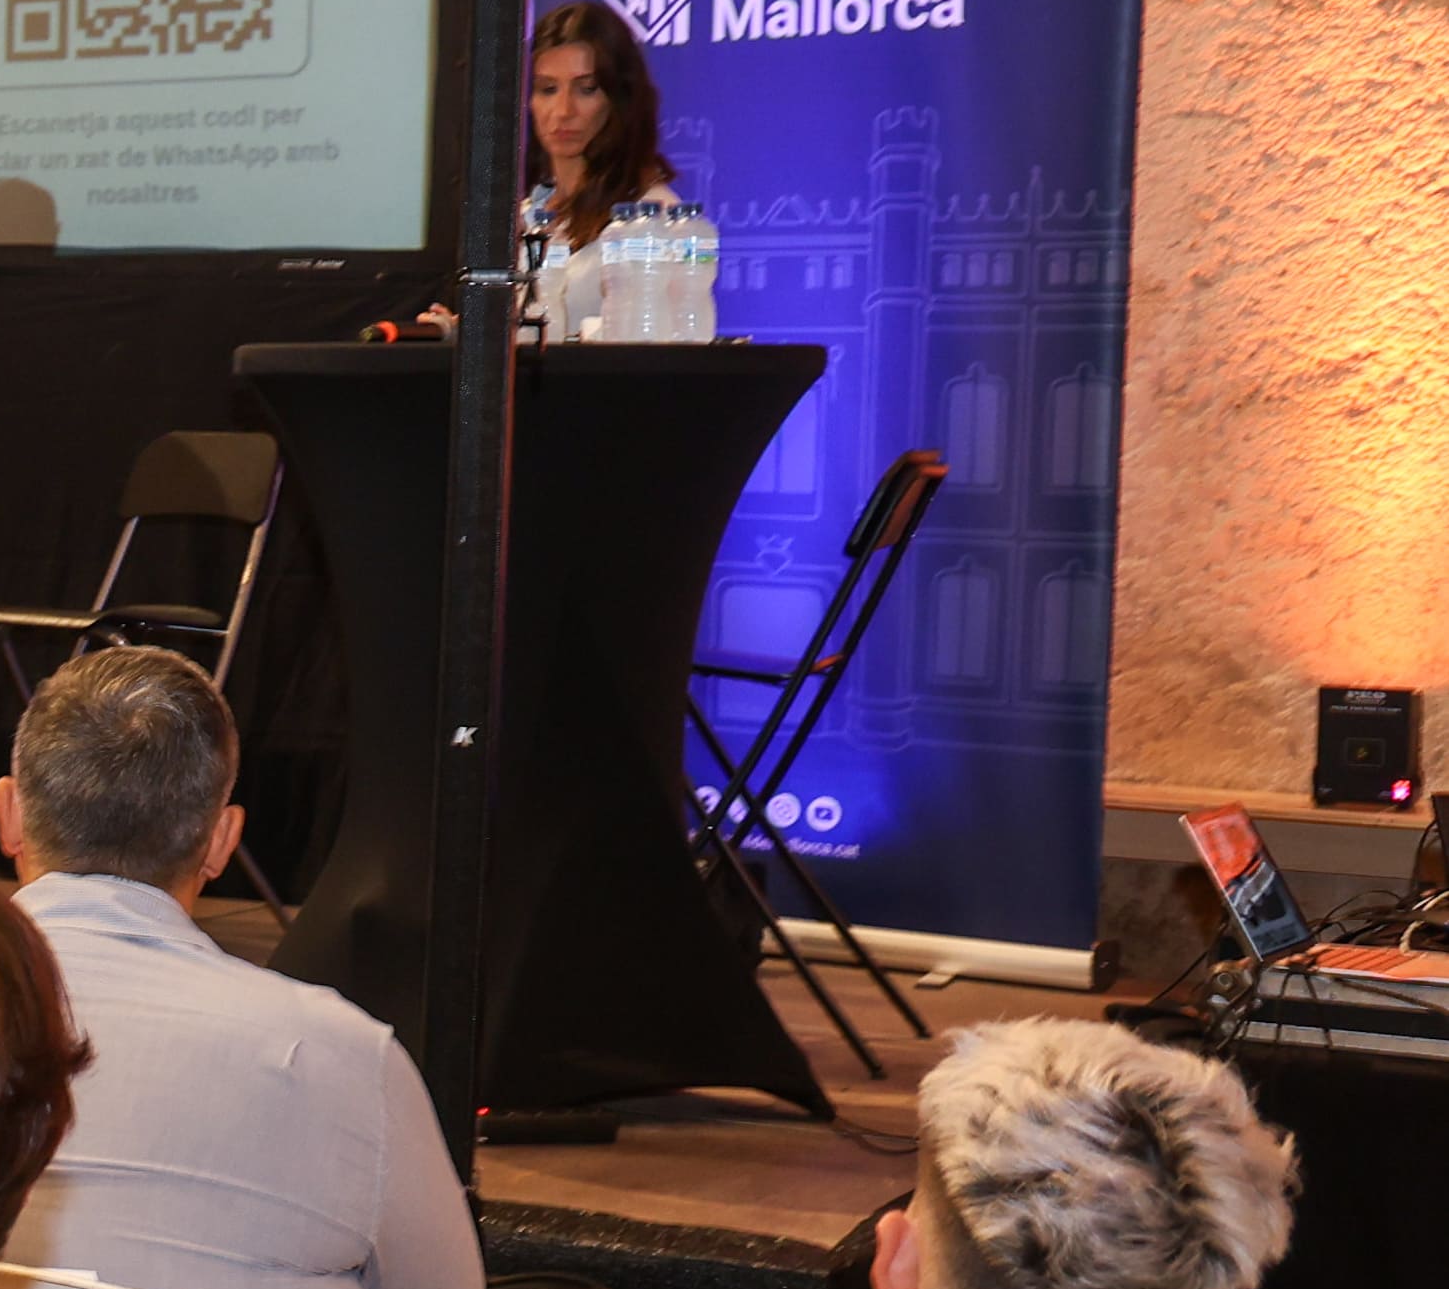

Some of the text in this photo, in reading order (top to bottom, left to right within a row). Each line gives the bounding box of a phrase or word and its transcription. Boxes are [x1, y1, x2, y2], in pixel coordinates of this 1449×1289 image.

[115, 108, 196, 136] aquest
[203, 106, 256, 128] codi
[262, 105, 306, 130] per
[38, 151, 68, 170] un
[116, 145, 147, 168] de
[153, 142, 280, 171] WhatsApp
[285, 137, 340, 164] amb
[87, 181, 199, 206] nosaltres
